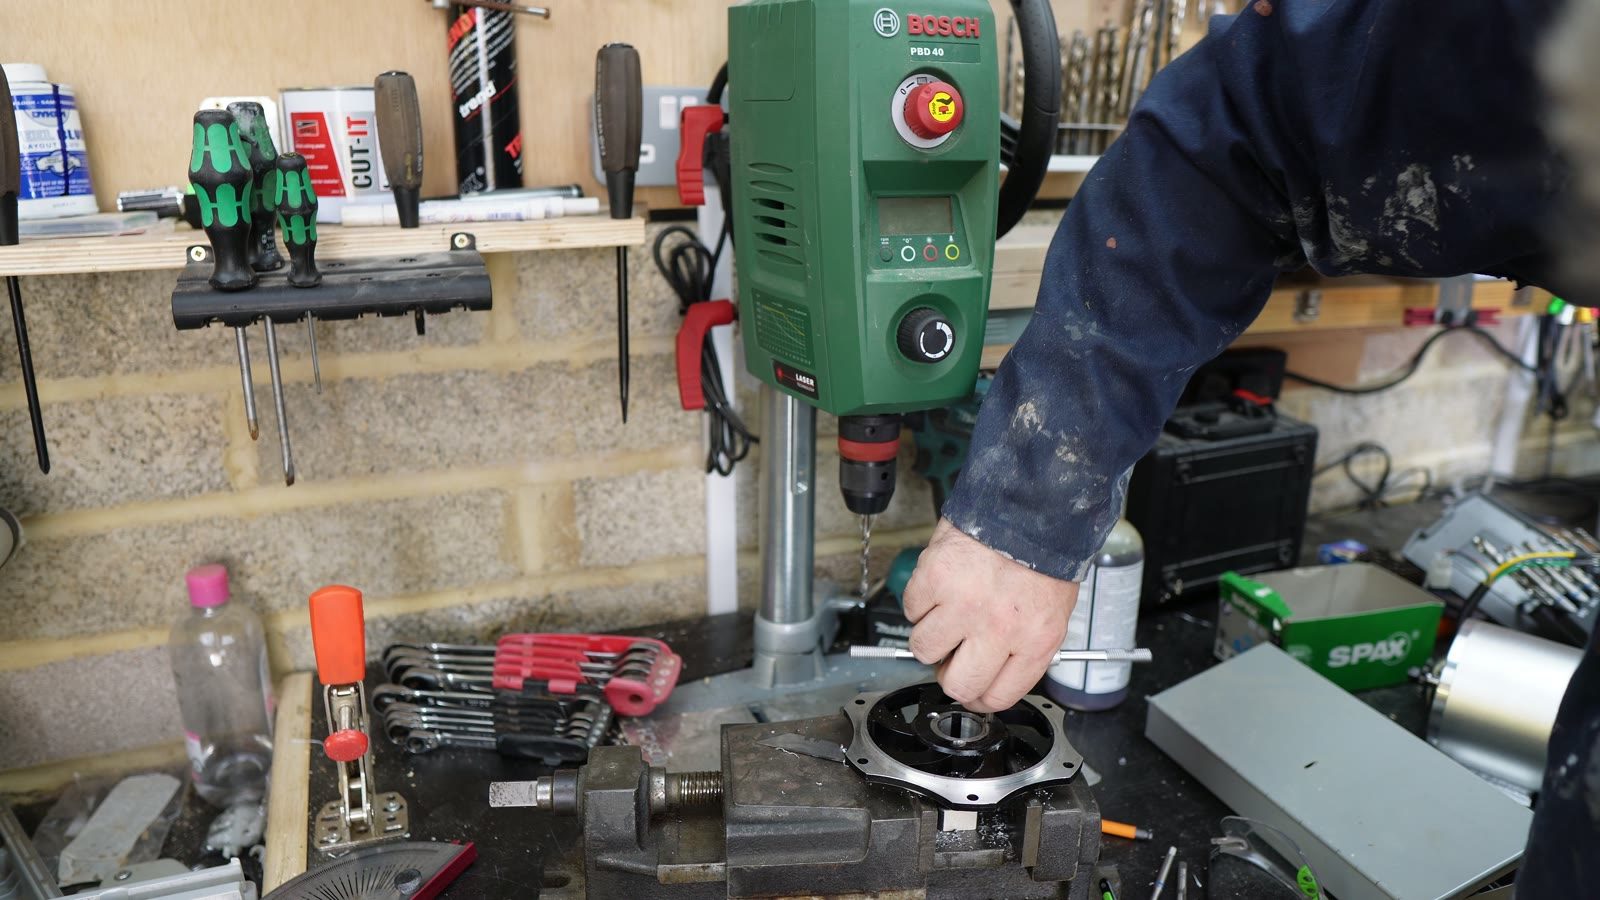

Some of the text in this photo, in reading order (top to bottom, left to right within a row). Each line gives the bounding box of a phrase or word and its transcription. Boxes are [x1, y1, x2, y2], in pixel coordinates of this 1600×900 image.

[907, 14, 980, 38] BOSCH
[910, 47, 944, 56] PBD 40
[459, 80, 497, 118] trend
[346, 115, 373, 189] CUT-IT
[795, 373, 815, 386] LASER
[1327, 633, 1409, 669] SPAX
